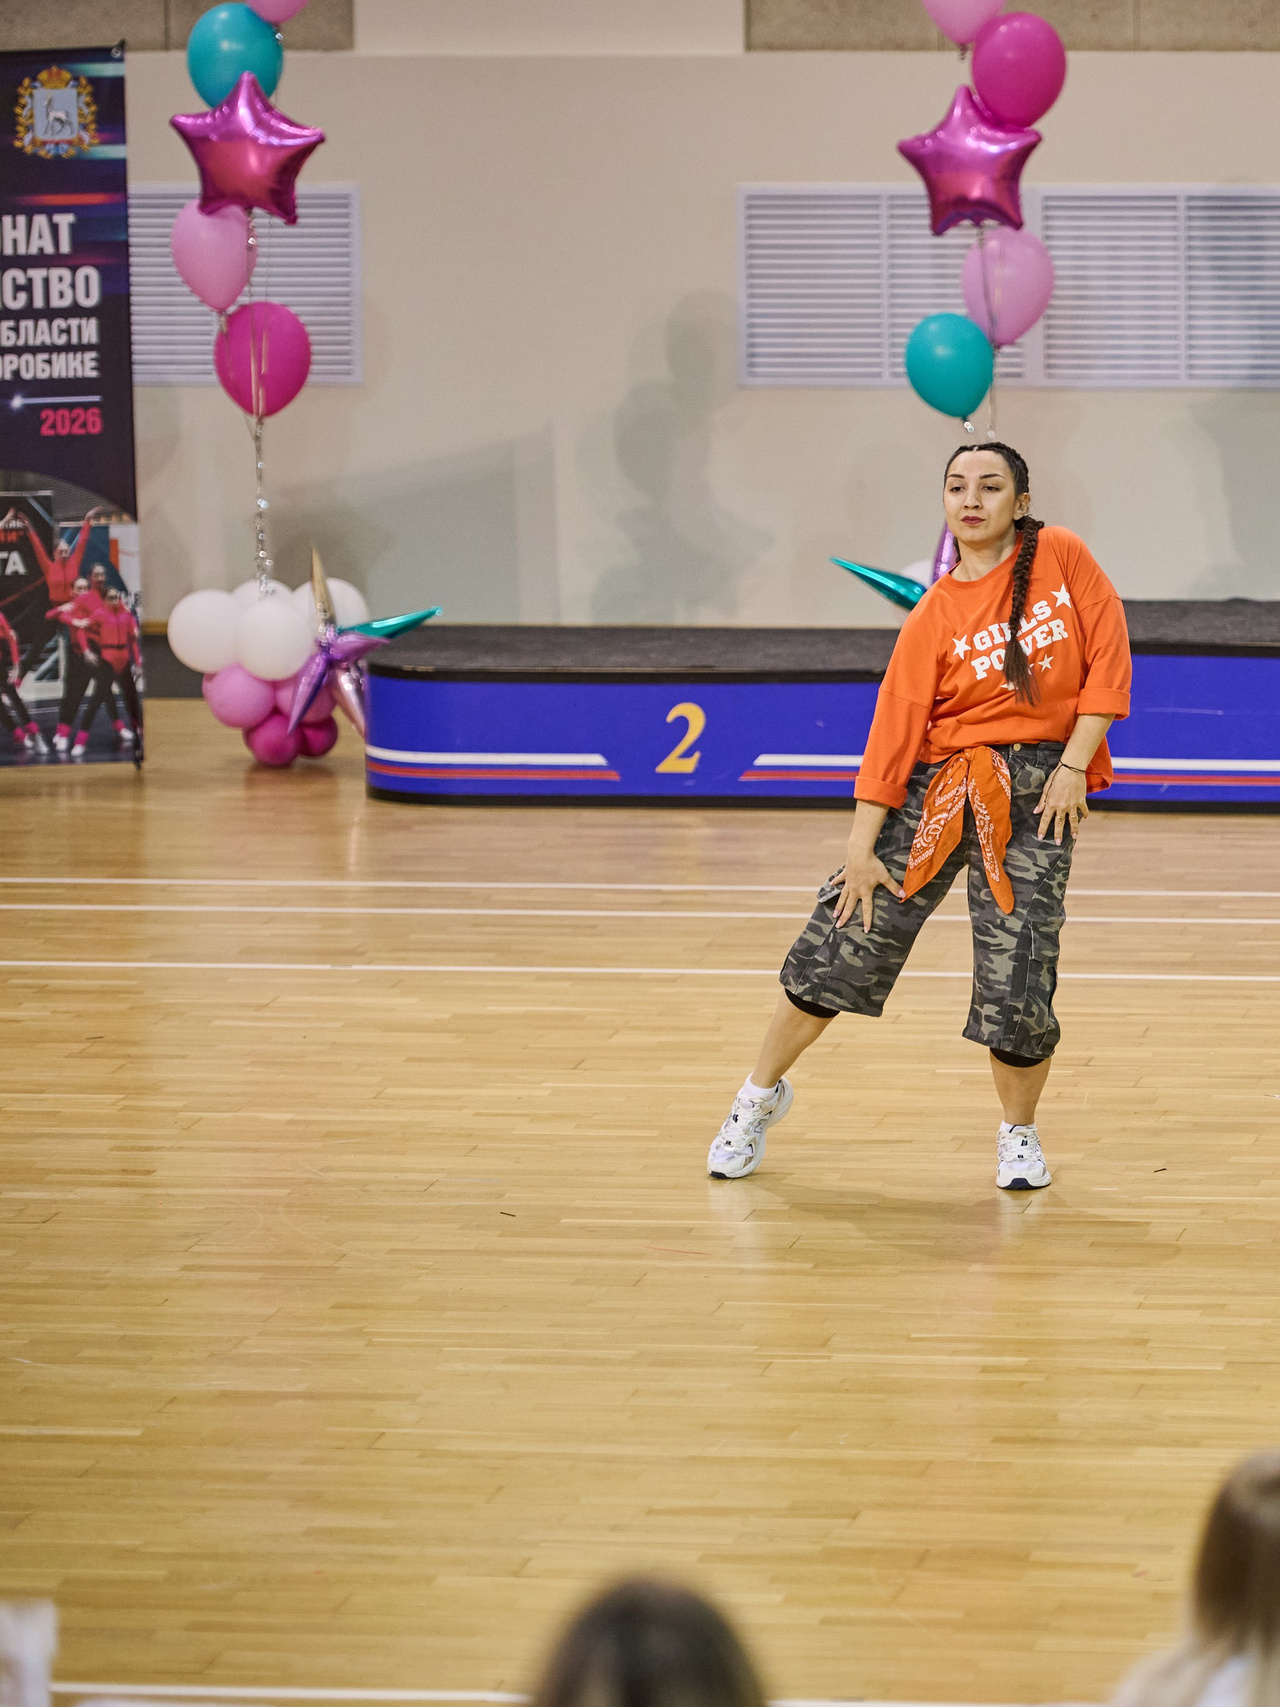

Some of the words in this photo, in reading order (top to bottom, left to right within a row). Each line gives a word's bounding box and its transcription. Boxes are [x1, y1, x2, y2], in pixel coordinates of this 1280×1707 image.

[1, 213, 75, 256] НАТ
[0, 317, 98, 347] БЛАСТИ
[0, 351, 98, 380] РОБИКЕ
[40, 407, 101, 436] 2026
[655, 702, 706, 774] 2
